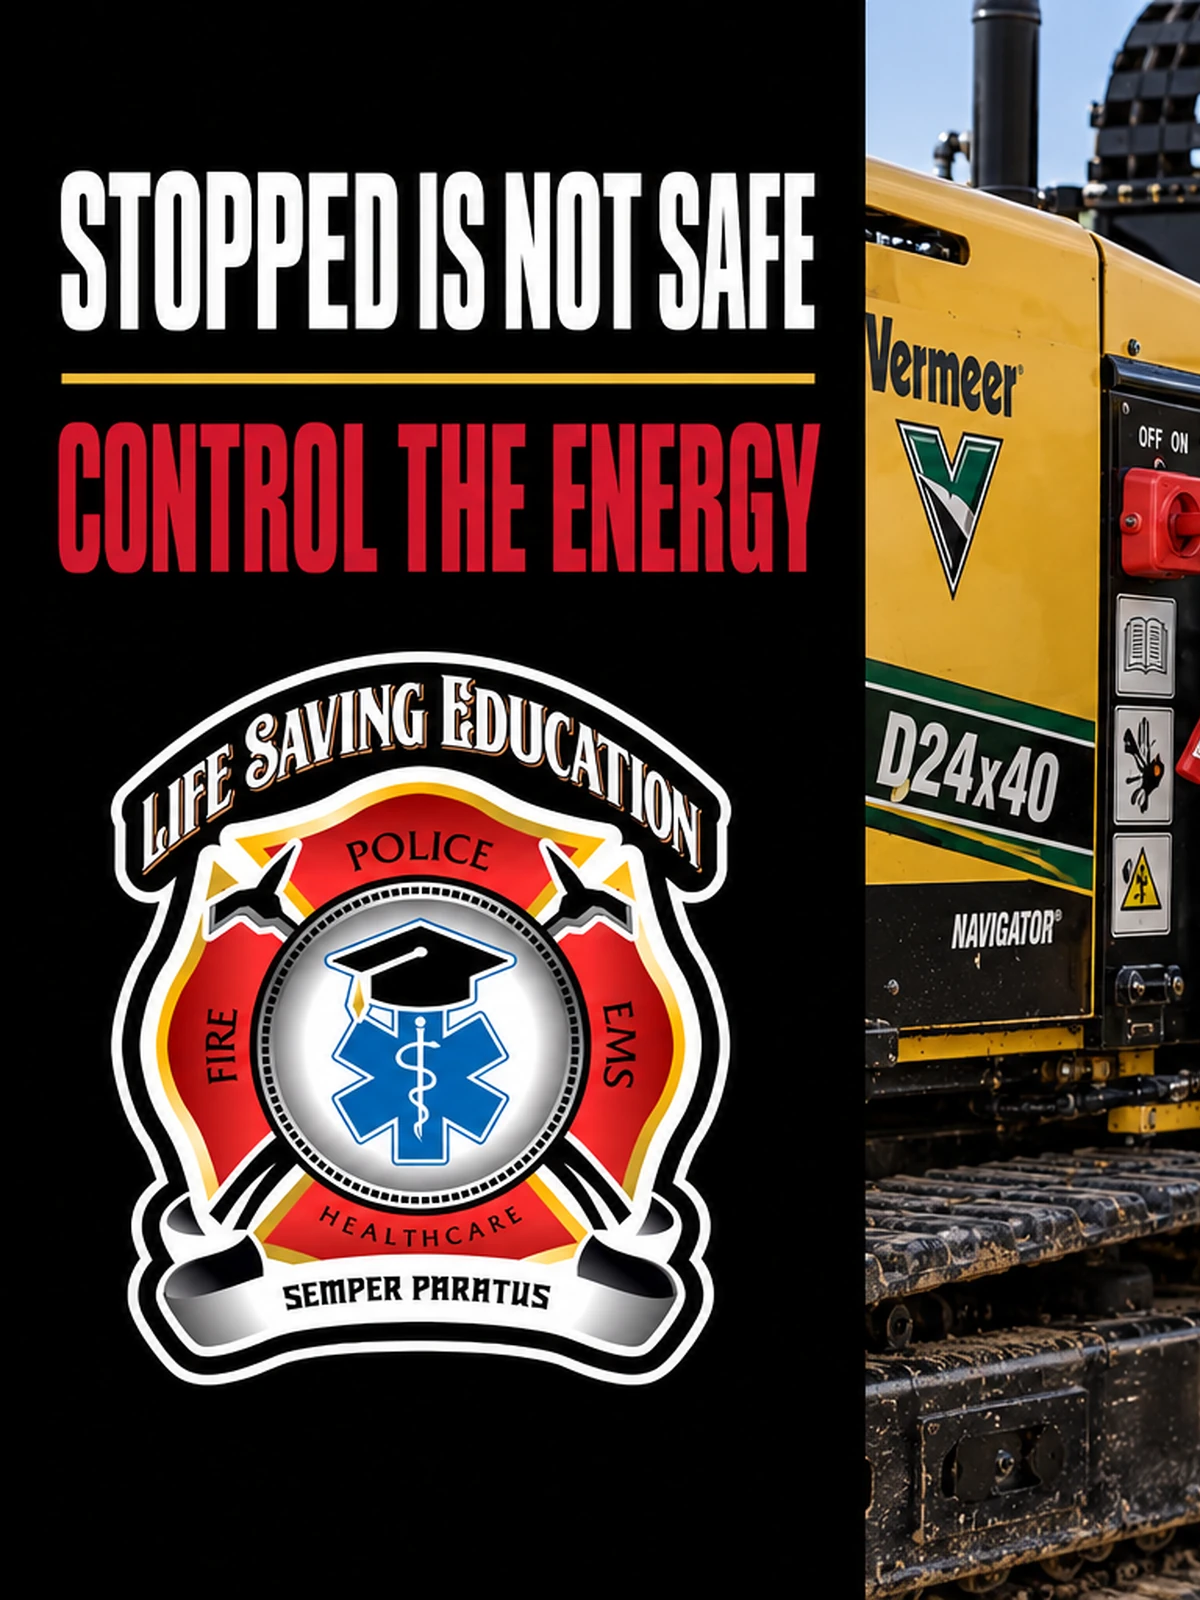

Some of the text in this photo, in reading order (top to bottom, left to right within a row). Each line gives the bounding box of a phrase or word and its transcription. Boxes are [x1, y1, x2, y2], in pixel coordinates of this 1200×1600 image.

[1138, 425, 1189, 454] OFF ON
[875, 711, 1061, 824] D24x40
